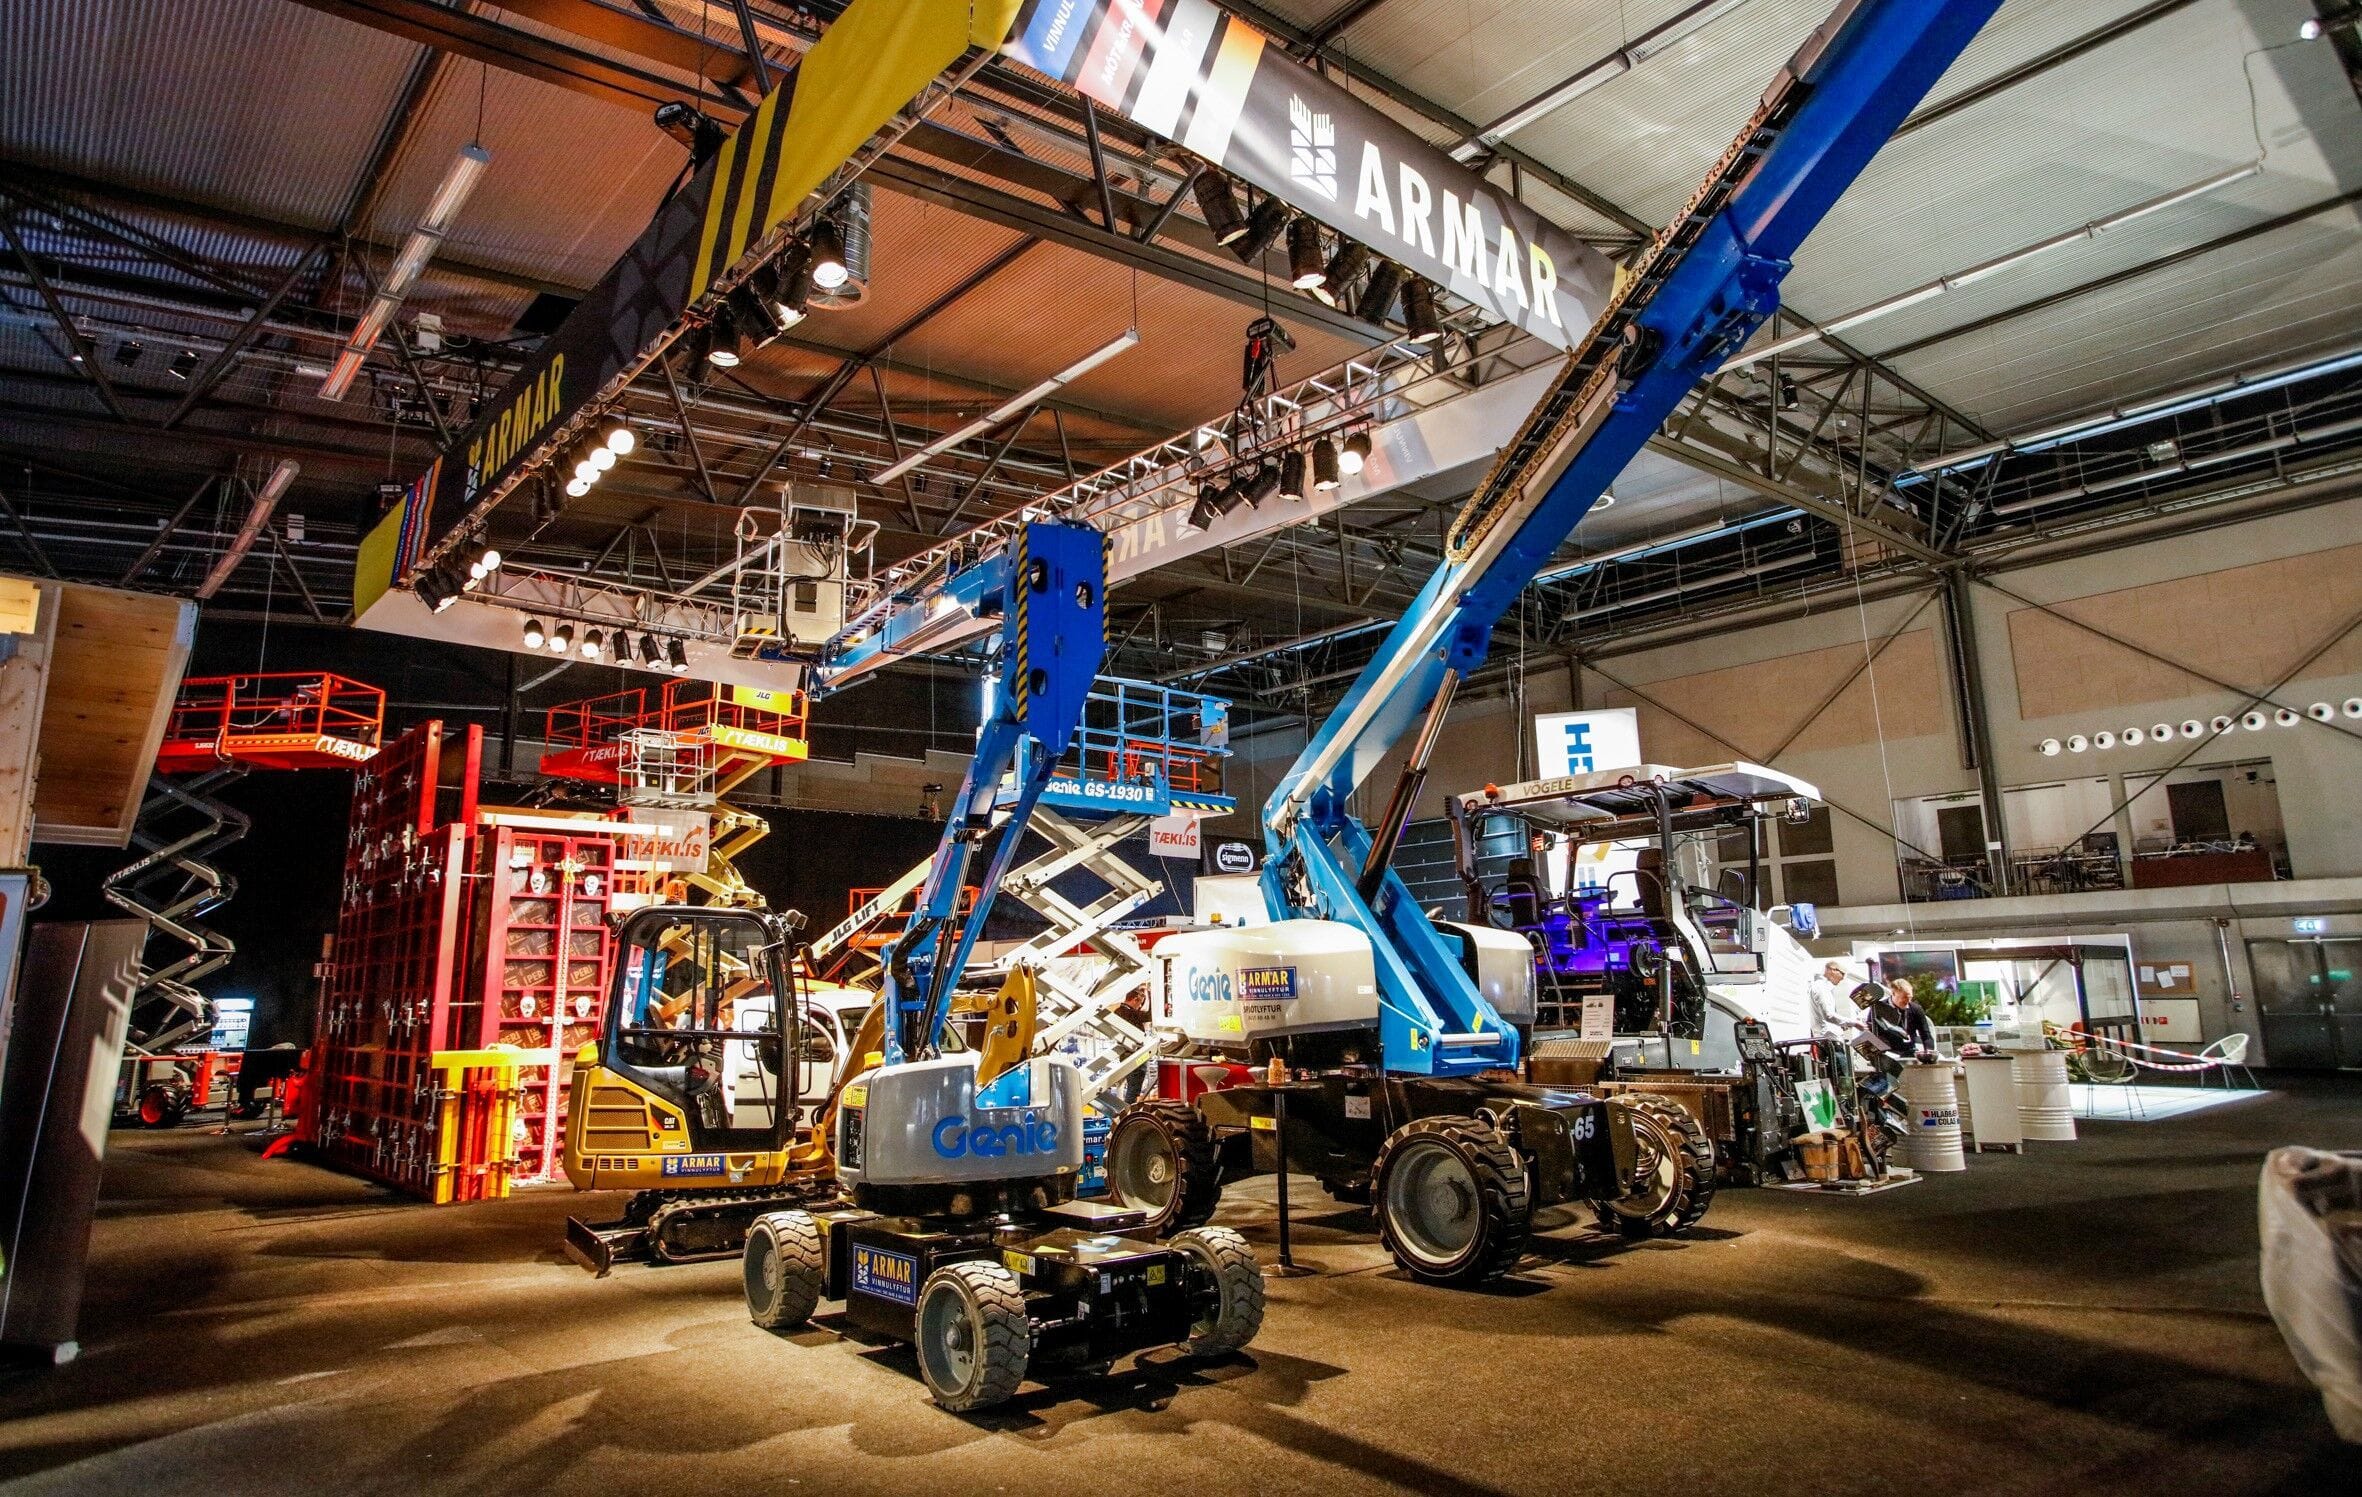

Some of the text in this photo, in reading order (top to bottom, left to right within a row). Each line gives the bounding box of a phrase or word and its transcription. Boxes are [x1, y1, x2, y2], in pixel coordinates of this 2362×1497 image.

[1355, 141, 1561, 328] ARMAR
[481, 353, 564, 487] ARMAR
[756, 690, 771, 700] JLG
[1084, 782, 1143, 802] GS-1930
[1523, 777, 1573, 796] VÖGELE
[831, 899, 879, 943] JLG LIFT
[527, 969, 547, 984] PERI
[574, 965, 593, 980] PERI
[1248, 970, 1289, 986] ARMAR
[1188, 966, 1232, 1001] Genie
[932, 1110, 1057, 1159] Genie
[681, 1156, 720, 1168] ARMAR
[872, 1254, 911, 1283] ARMAR
[871, 1277, 911, 1294] VINNULYFTUR
